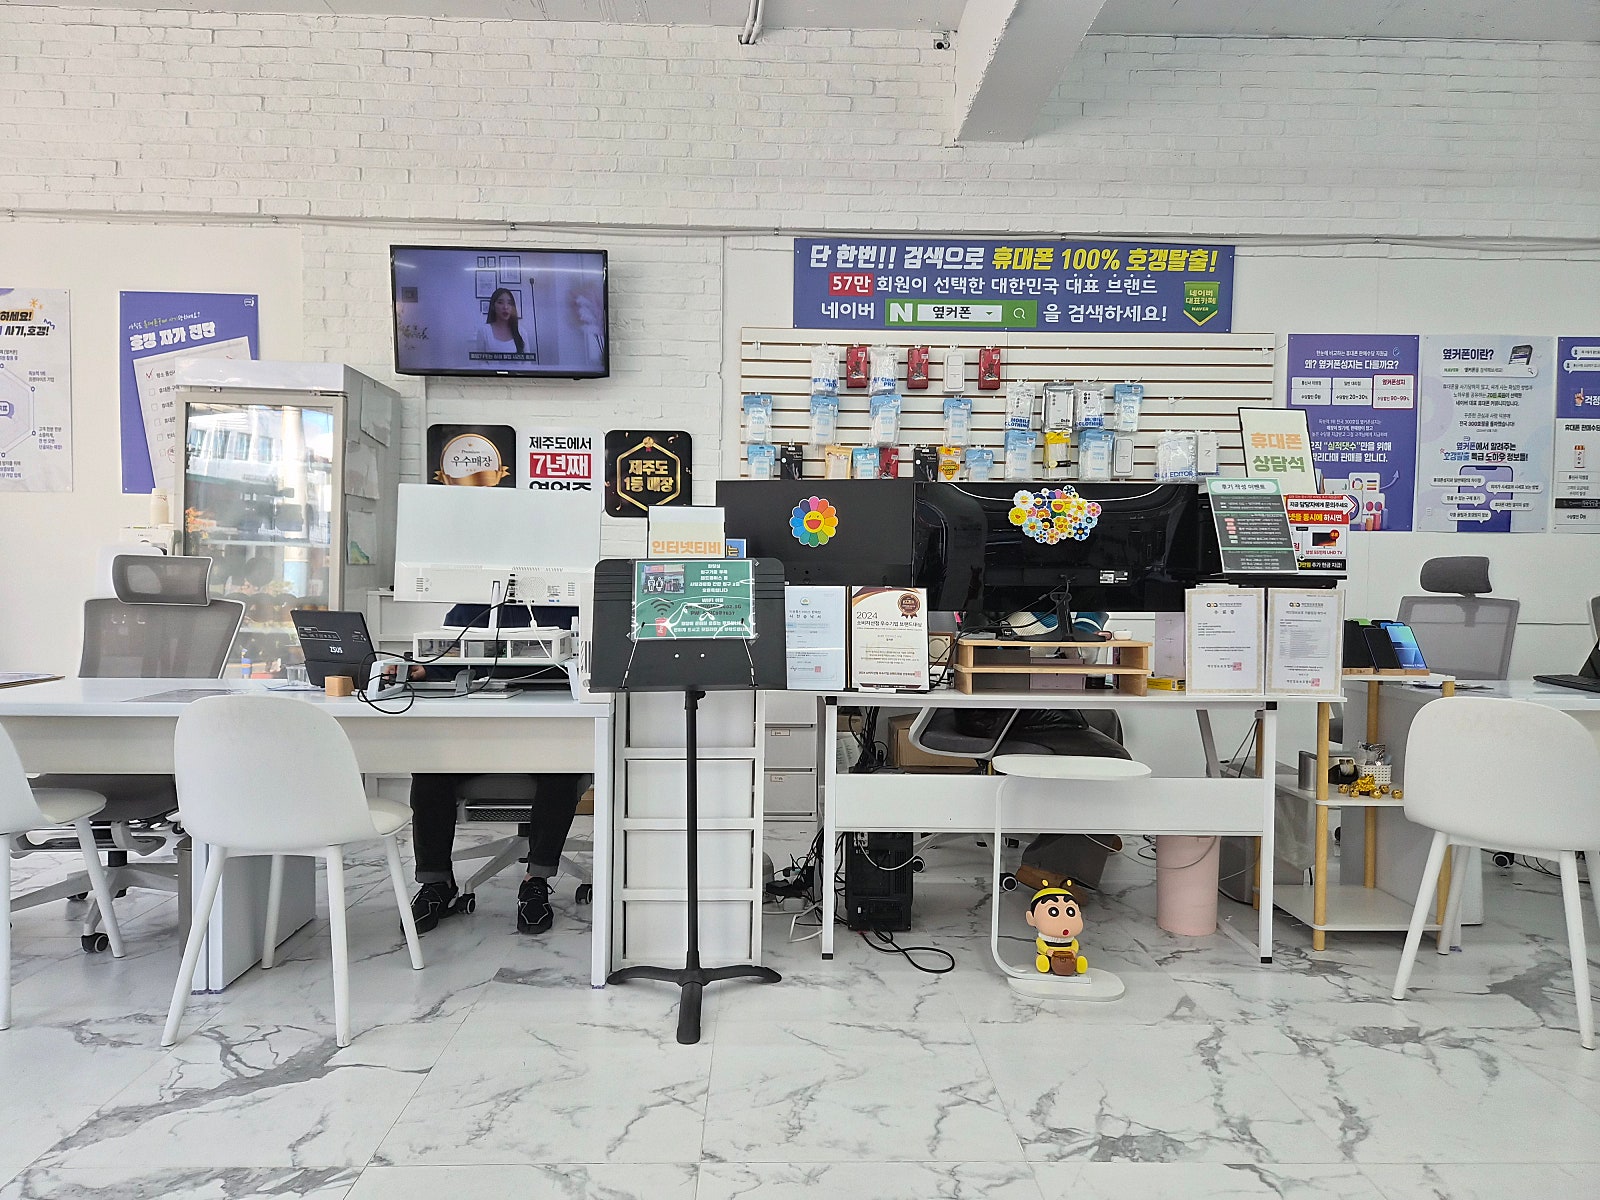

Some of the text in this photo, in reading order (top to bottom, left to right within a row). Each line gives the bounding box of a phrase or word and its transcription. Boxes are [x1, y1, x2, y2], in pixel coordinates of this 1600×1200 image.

[810, 244, 1218, 272] 단 한번!! 검색으로 휴대폰 100% 호갱탈출!
[832, 276, 1157, 296] 57만 회원이 선택한 대한민국 대표 브랜드
[1189, 289, 1214, 297] 네이버
[1185, 297, 1217, 305] 대표카페
[821, 302, 1167, 323] 네이버 N 옆커폰 을 검색하세요!
[130, 321, 216, 352] 호갱 자가 진단
[1442, 348, 1494, 360] 옆커폰이란?
[1305, 360, 1399, 369] 왜? 옆커폰성지는 다를까요?
[529, 436, 591, 450] 제주도에서
[1250, 432, 1302, 450] 휴대폰
[1377, 441, 1392, 451] 위해
[1456, 442, 1516, 450] 옆커폰에서 알려주는
[451, 455, 492, 467] 우수매장
[1341, 453, 1362, 462] 판매를
[1364, 453, 1388, 462] 합니다.
[1485, 452, 1506, 461] 노하우
[533, 454, 589, 477] 7년째
[628, 459, 668, 475] 제주도
[1252, 455, 1306, 472] 상담석
[623, 476, 674, 492] 1등 매장
[1323, 514, 1342, 522] 하시면
[651, 541, 721, 555] 인터넷티비
[856, 611, 878, 620] 2024
